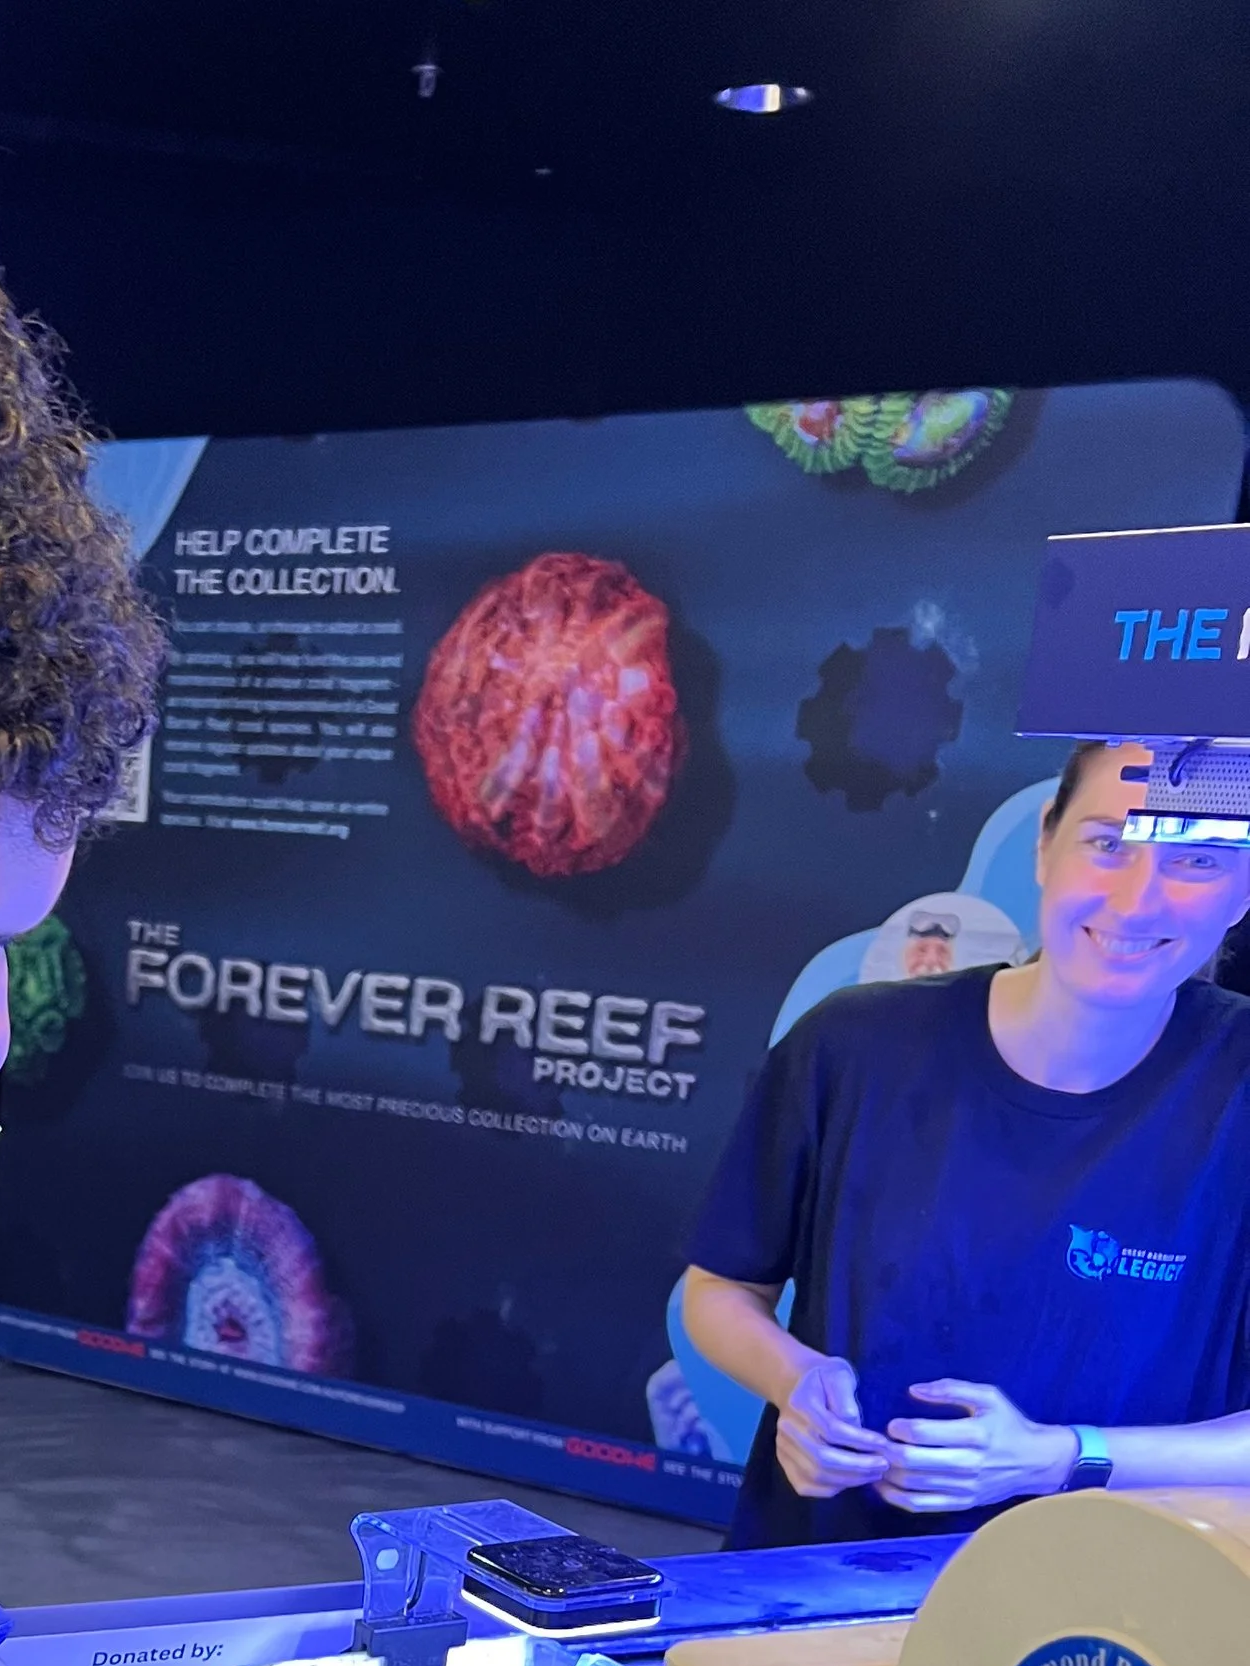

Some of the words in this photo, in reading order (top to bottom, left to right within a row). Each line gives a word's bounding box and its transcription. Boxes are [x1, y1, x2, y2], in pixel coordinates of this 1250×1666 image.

[175, 530, 241, 556] HELP
[244, 525, 391, 555] COMPLETE
[174, 568, 223, 595] THE
[227, 567, 400, 595] COLLECTION.
[1115, 608, 1228, 660] THE
[128, 920, 180, 946] THE
[126, 948, 464, 1042] FOREVER
[480, 985, 706, 1065] REEF
[534, 1056, 695, 1101] PROJECT
[204, 1073, 286, 1099] COMPLETE
[291, 1083, 321, 1105] THE
[325, 1090, 374, 1111] MOST
[377, 1095, 465, 1125] PRECIOUS
[468, 1107, 583, 1140] COLLECTION
[587, 1122, 617, 1144] ON
[621, 1127, 688, 1153] EARTH
[92, 1644, 186, 1666] Donated
[191, 1643, 224, 1661] by:
